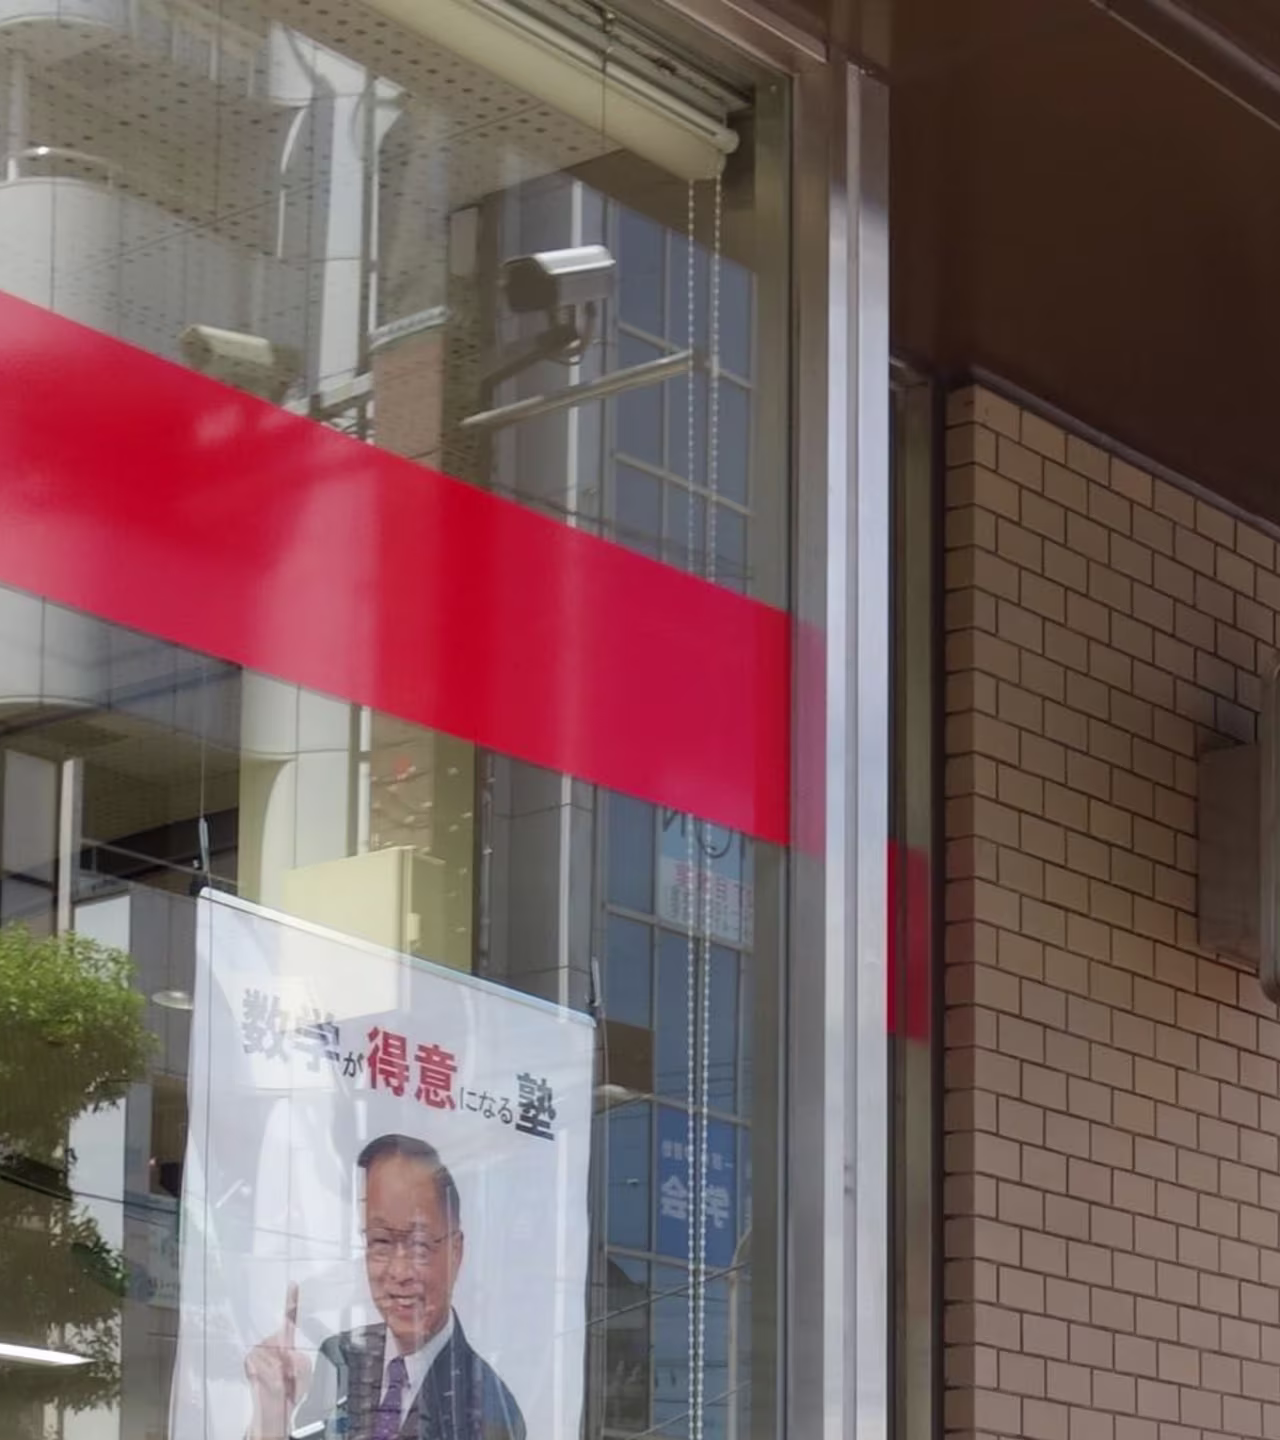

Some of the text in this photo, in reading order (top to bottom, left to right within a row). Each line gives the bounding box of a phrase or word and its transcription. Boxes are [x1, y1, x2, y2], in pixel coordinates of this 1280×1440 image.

[242, 988, 557, 1141] 数学が得意になる塾
